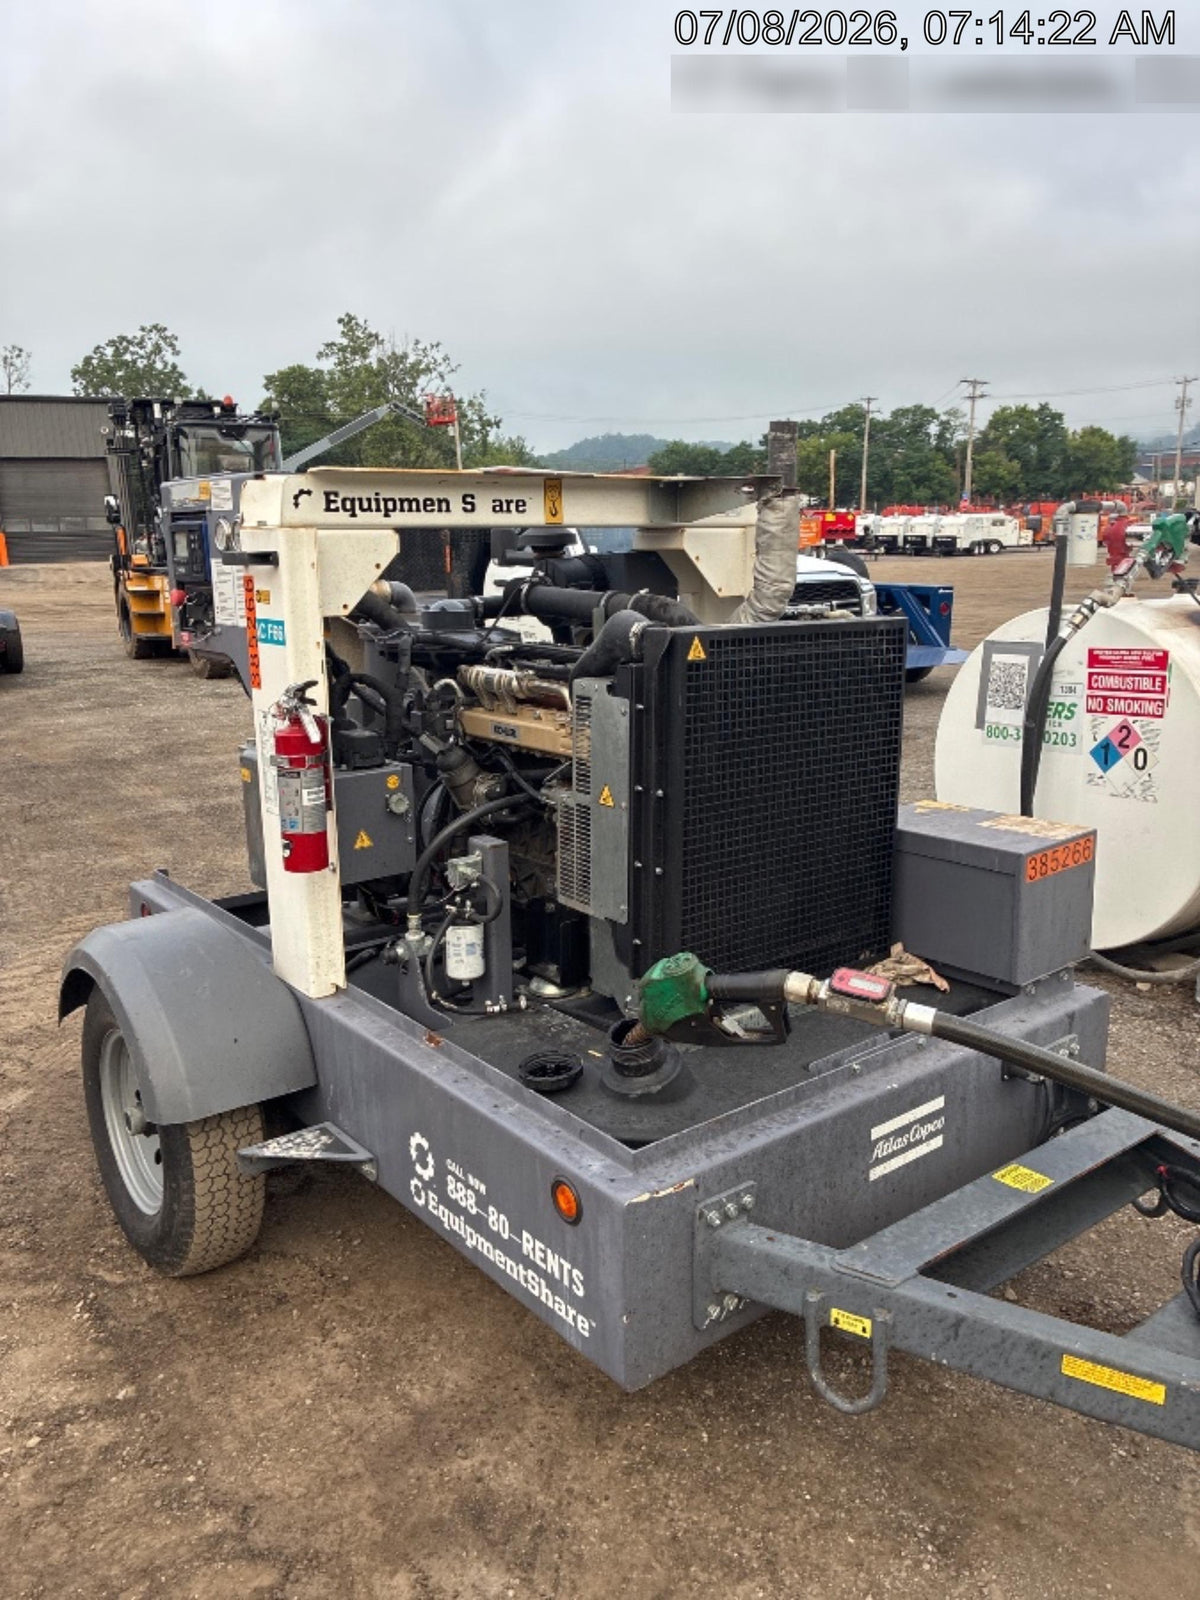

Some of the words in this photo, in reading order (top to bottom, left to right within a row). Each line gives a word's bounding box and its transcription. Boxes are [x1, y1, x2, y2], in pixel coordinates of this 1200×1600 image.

[1091, 675, 1163, 692] COMBUSTIBLE
[1087, 697, 1104, 712] NO
[1106, 699, 1163, 716] SMOKING
[1118, 725, 1132, 749] 2
[1101, 743, 1110, 766] 1
[1134, 748, 1148, 771] 0
[1028, 838, 1092, 881] 385266
[869, 1136, 909, 1164] Atlas
[909, 1116, 945, 1142] Copco
[447, 1174, 585, 1298] 888-80-RENTS
[427, 1189, 591, 1338] EquipmentShare
